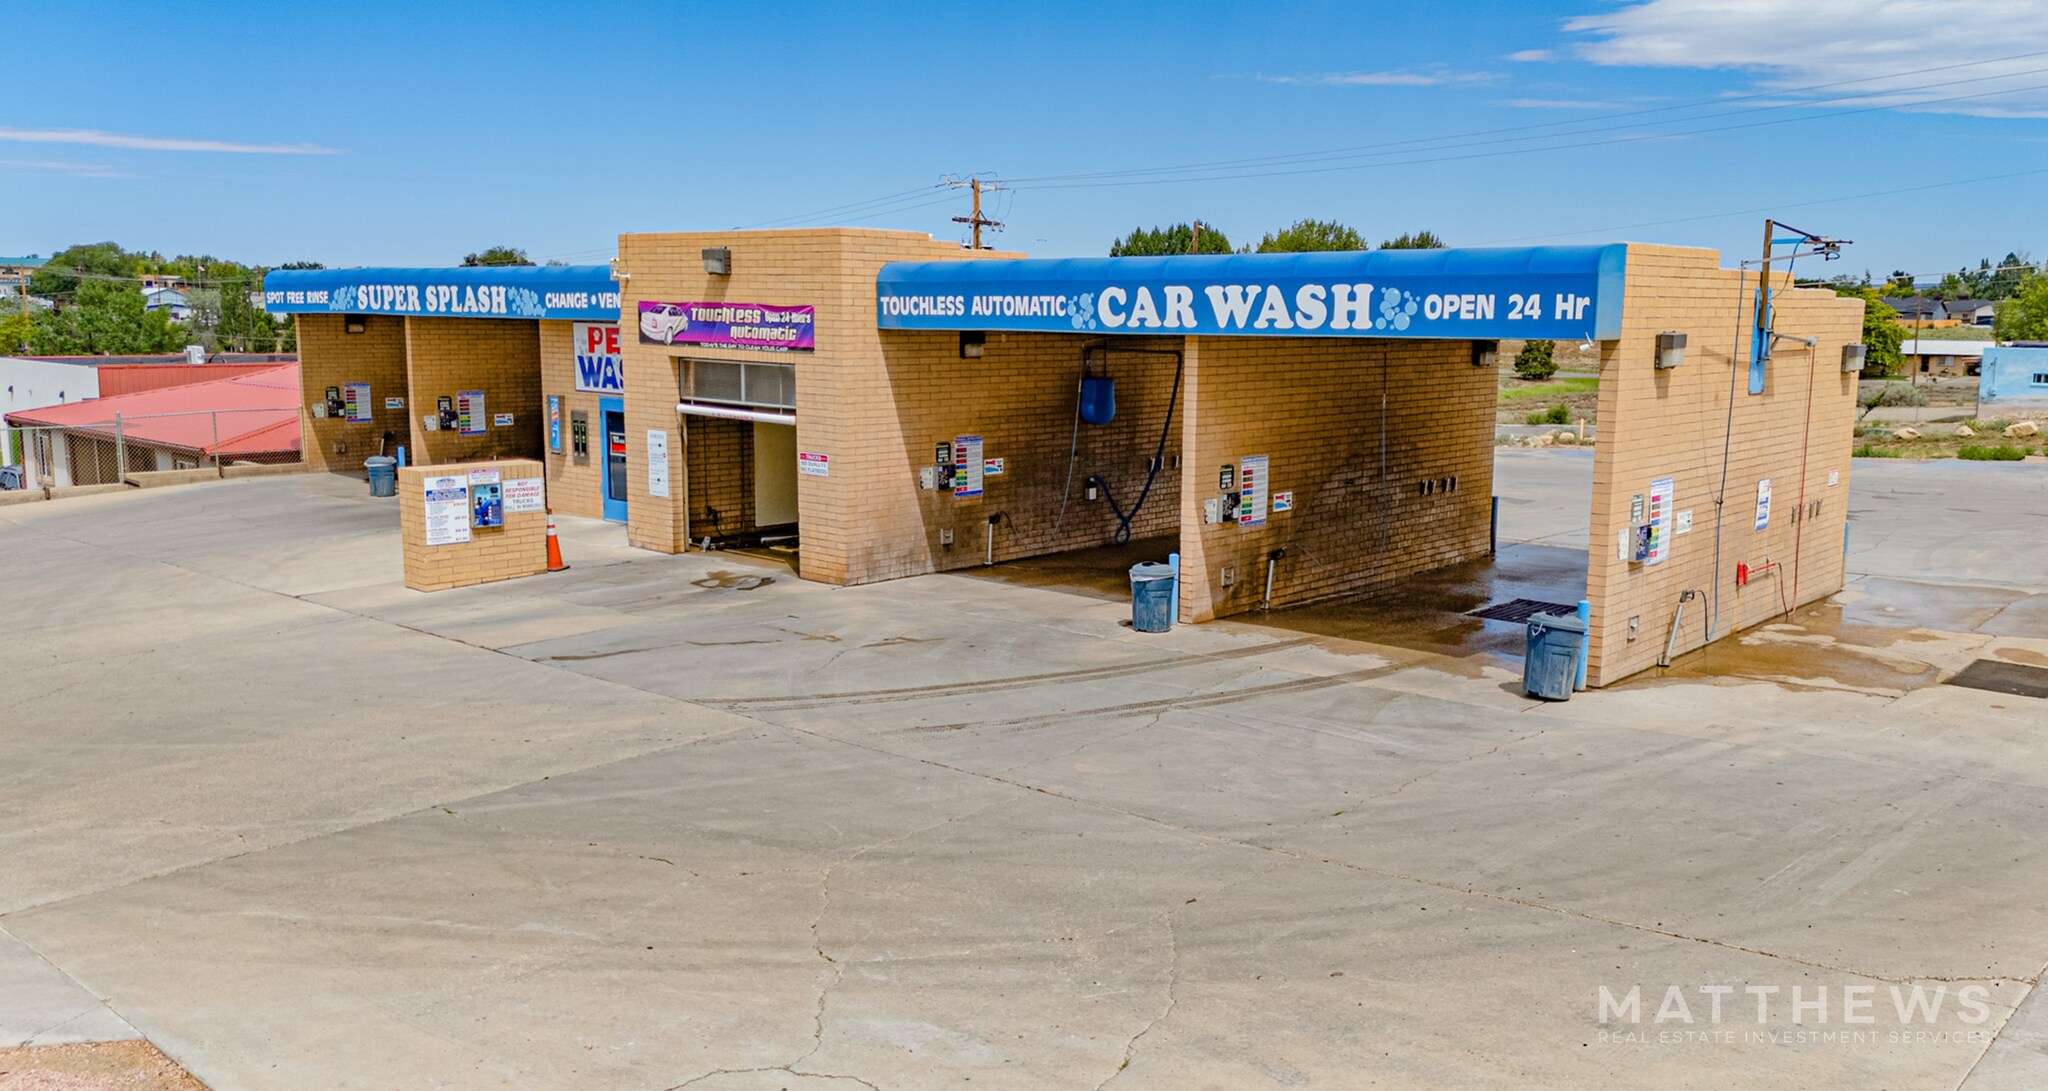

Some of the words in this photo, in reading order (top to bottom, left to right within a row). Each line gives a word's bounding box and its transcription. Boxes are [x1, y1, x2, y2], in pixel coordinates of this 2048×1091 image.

[266, 291, 285, 305] SPOT
[286, 291, 305, 304] FREE
[306, 291, 329, 304] RINSE
[357, 285, 420, 311] SUPER
[425, 285, 508, 314] SPLASH
[545, 292, 588, 309] CHANGE
[880, 295, 965, 317] TOUCHLESS
[970, 295, 1067, 317] AUTOMATIC
[1097, 285, 1198, 329] CAR
[1204, 283, 1375, 331] WASH
[1424, 293, 1496, 321] OPEN
[1507, 293, 1543, 321] 24
[1555, 294, 1591, 321] Hr
